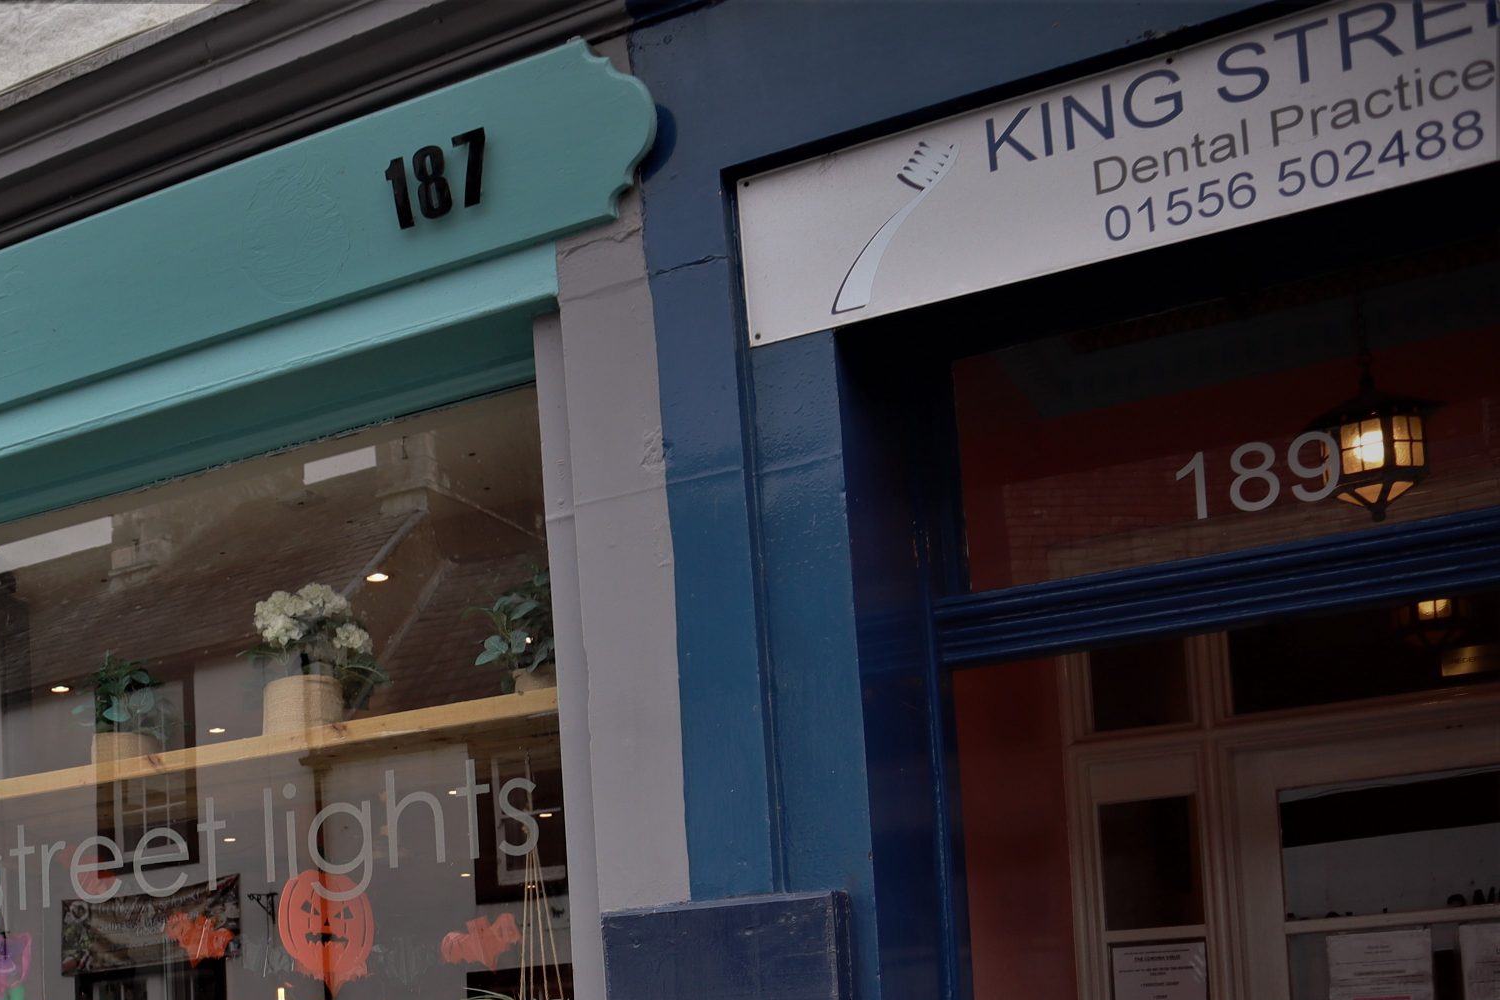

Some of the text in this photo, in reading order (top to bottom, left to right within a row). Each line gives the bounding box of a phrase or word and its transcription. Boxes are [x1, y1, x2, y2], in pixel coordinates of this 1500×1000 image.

[985, 0, 1500, 173] KING STRE
[1093, 59, 1495, 196] Dental Practice
[384, 126, 486, 230] 187
[1104, 110, 1484, 241] 01556 502488
[1175, 431, 1341, 520] 189
[263, 759, 540, 901] lights
